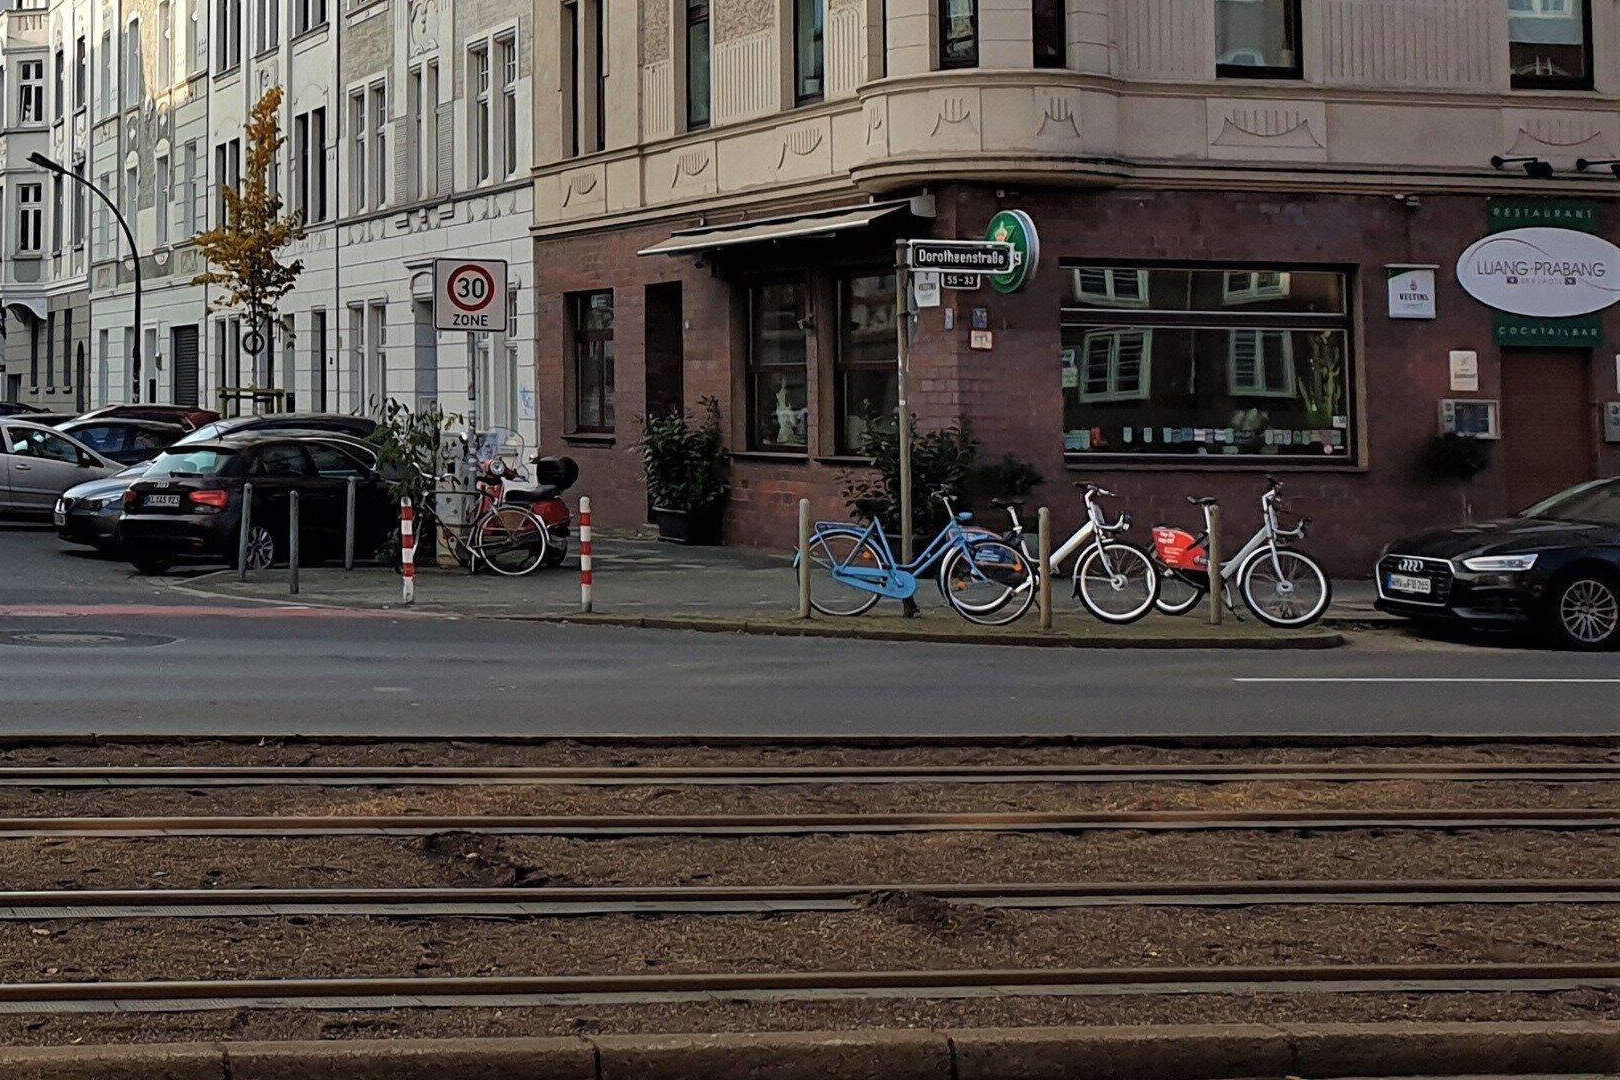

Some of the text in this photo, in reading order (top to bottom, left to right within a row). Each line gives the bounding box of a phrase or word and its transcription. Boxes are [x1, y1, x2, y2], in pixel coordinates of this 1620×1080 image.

[1493, 206, 1593, 219] RESTAURANT
[918, 248, 1005, 264] Dorotheenstraße
[457, 276, 485, 299] 30
[452, 313, 489, 327] ZONE
